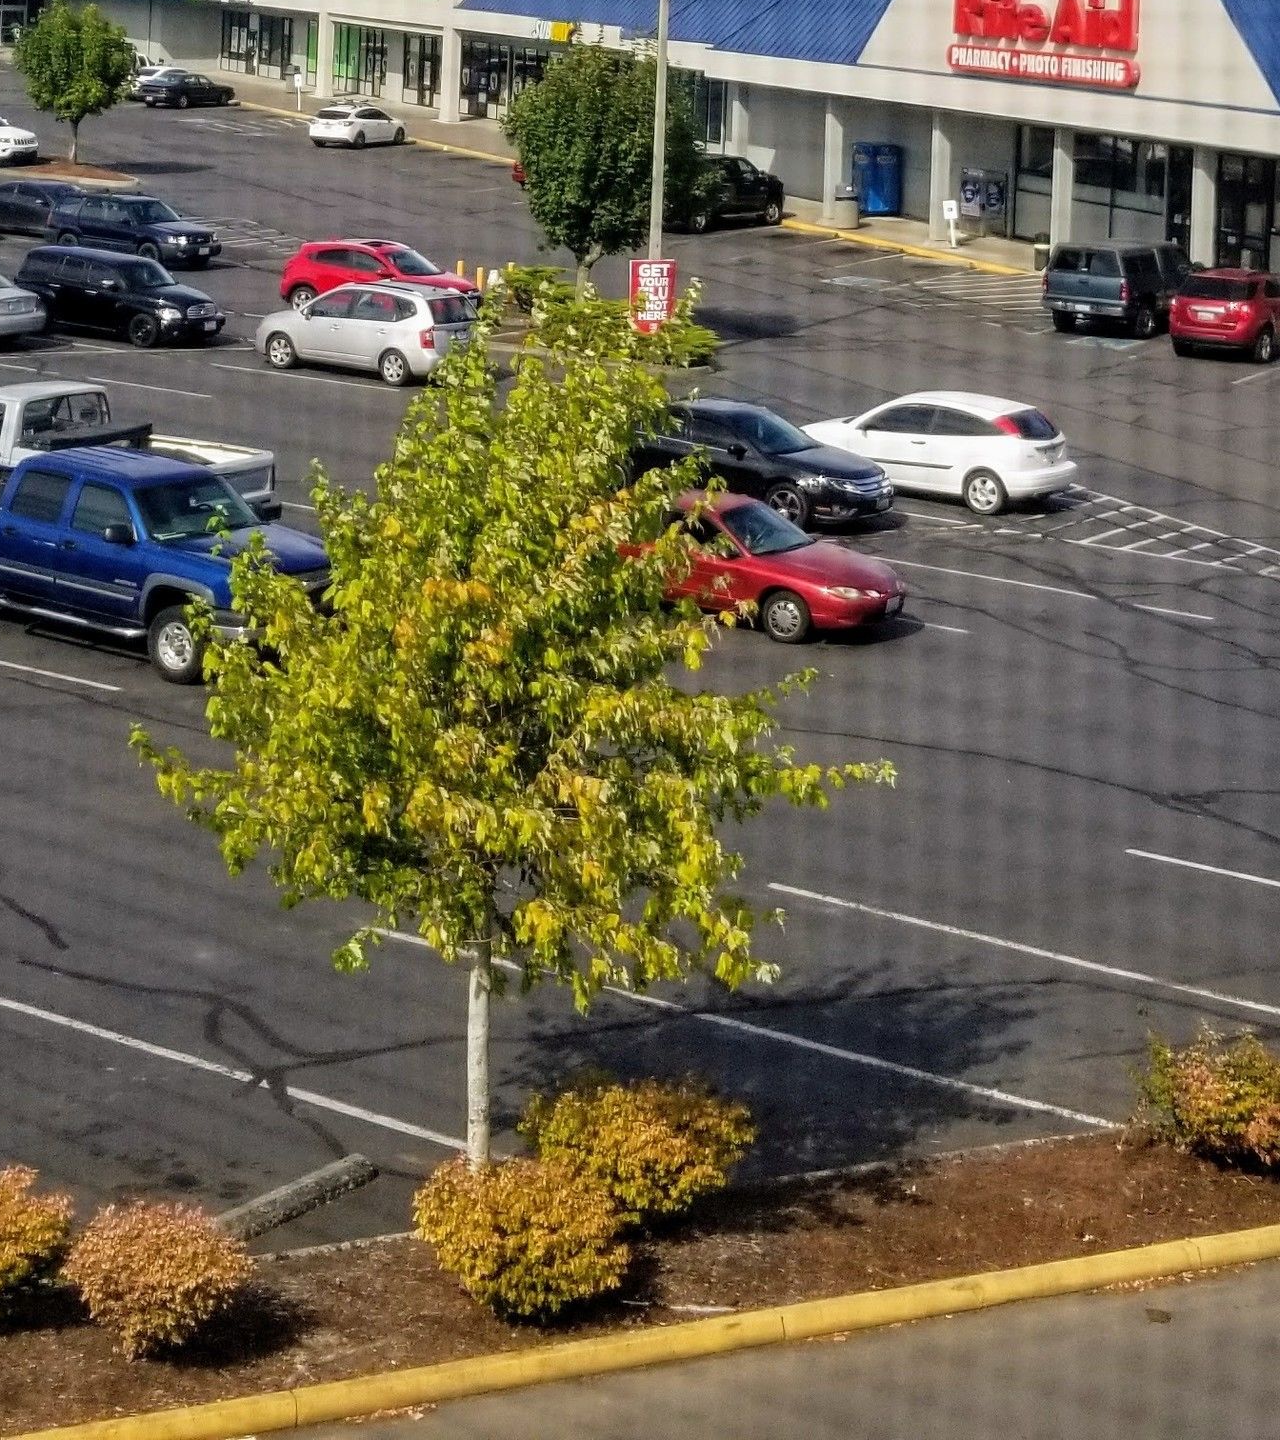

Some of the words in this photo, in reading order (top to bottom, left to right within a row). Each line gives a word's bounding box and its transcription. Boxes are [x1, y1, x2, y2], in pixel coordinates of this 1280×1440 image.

[951, 46, 1011, 71] PHARMACY
[1019, 53, 1059, 75] PHOTO
[1061, 56, 1125, 81] FINISHING
[638, 263, 670, 277] GET
[638, 277, 669, 286] YOUR
[639, 301, 668, 310] HOT
[637, 311, 668, 320] HERE
